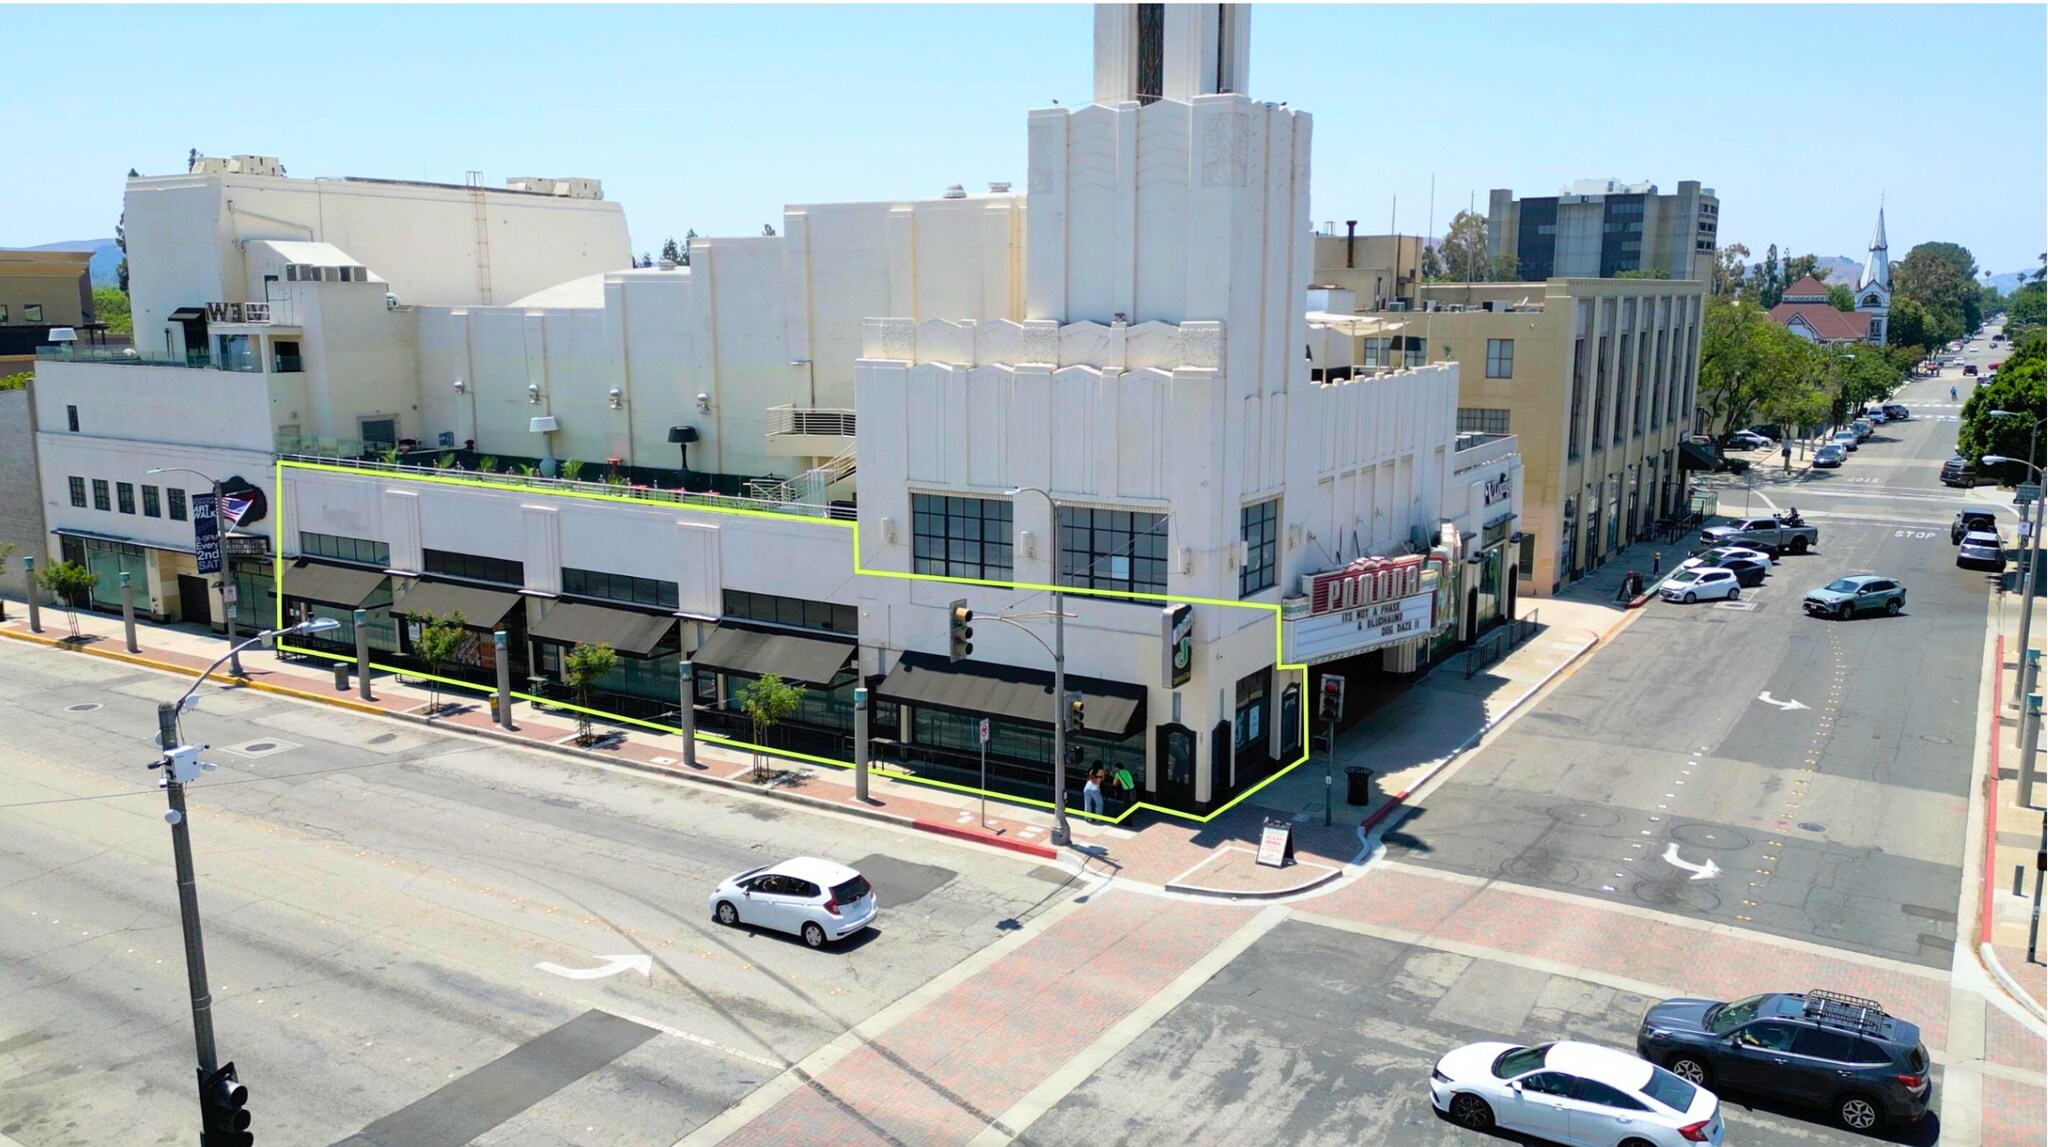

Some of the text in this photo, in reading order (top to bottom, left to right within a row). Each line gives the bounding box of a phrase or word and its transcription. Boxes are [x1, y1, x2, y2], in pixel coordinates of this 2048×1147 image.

[194, 511, 216, 519] WALK
[1894, 530, 1936, 539] STOP
[196, 542, 219, 550] Every
[197, 549, 220, 560] 2nd
[199, 559, 220, 570] SAT
[1328, 565, 1418, 611] POMONA
[1342, 602, 1401, 623] ITS NOT A PHASE
[1357, 623, 1363, 631] &
[1381, 626, 1394, 636] DOG
[1397, 621, 1412, 633] DAZE
